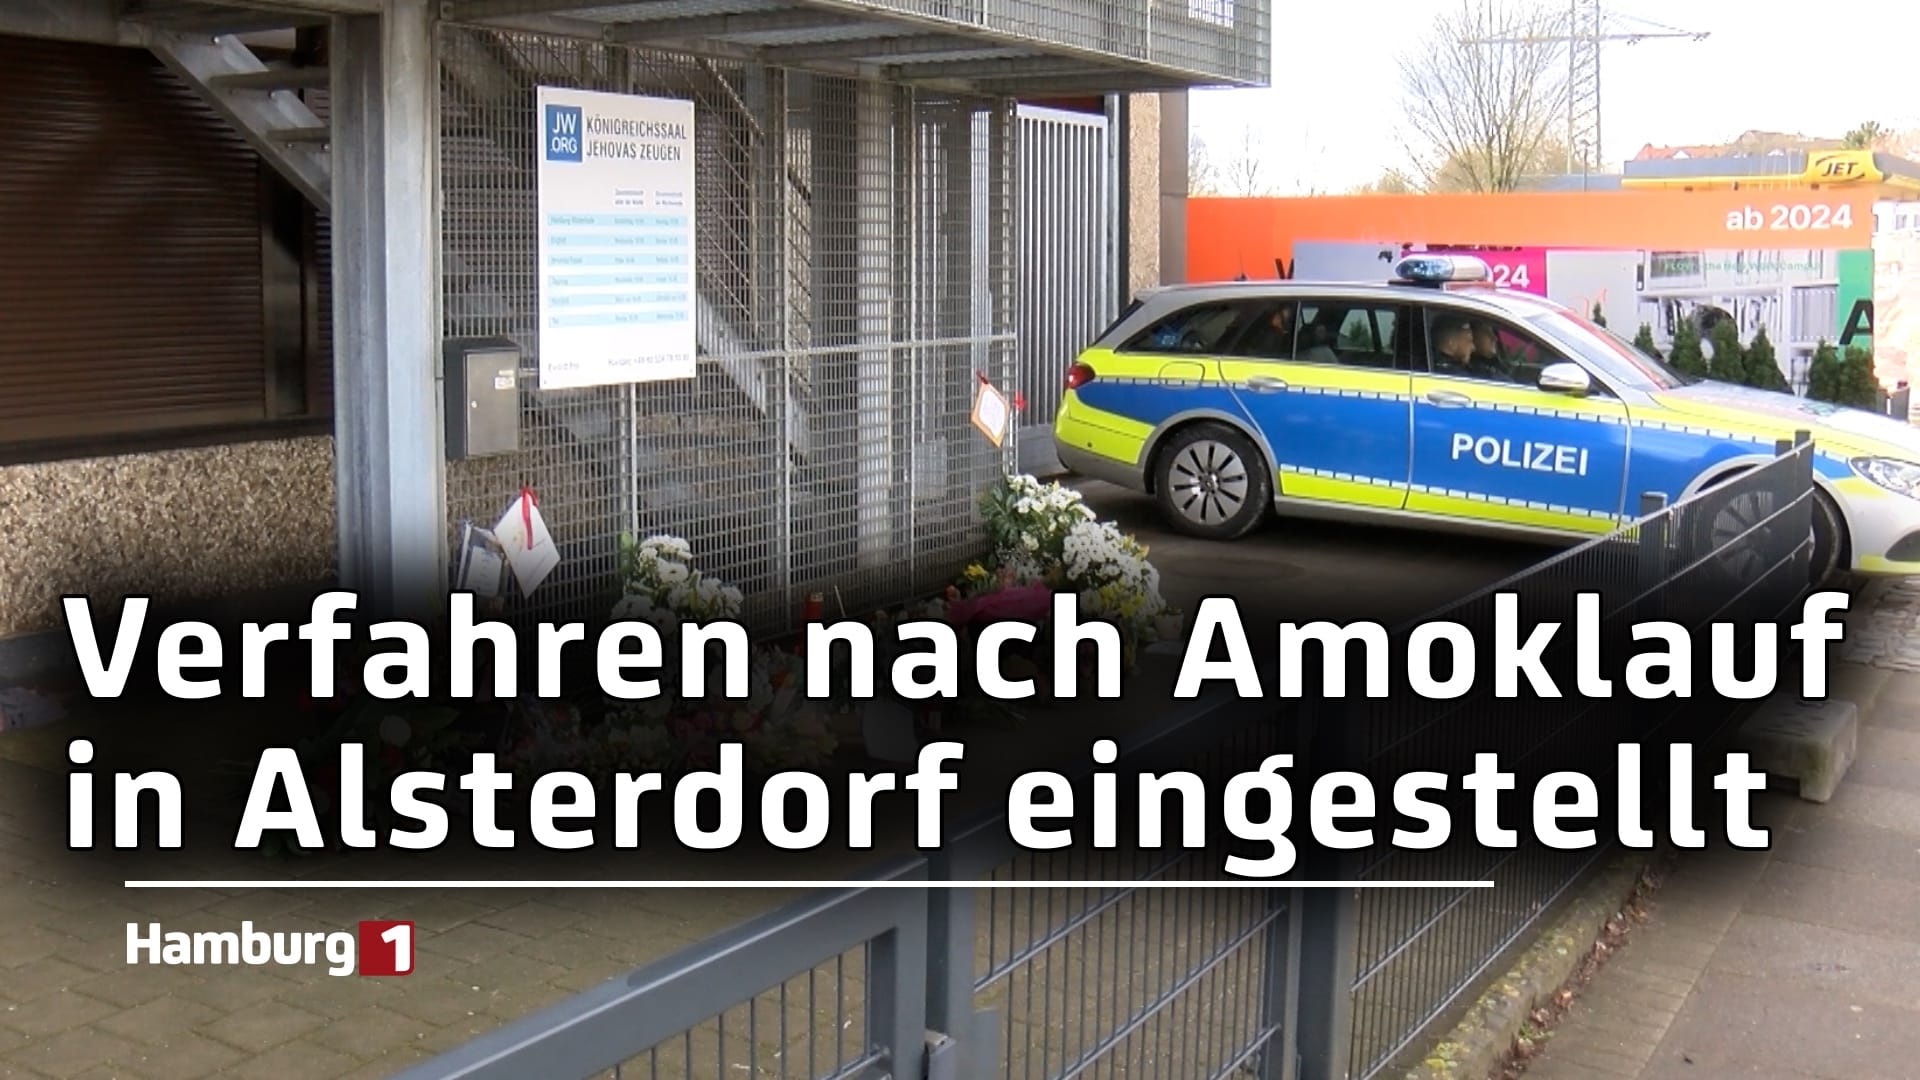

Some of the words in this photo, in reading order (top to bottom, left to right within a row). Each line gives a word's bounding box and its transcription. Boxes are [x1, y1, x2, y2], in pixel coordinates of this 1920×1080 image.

[552, 112, 577, 135] JW
[586, 114, 687, 140] KÖNIGREICHSSAAL
[586, 141, 636, 160] JEHOVAS
[640, 144, 681, 161] ZEUGEN
[1822, 162, 1858, 177] JET
[1726, 205, 1764, 230] ab
[1770, 204, 1853, 230] 2024
[1490, 263, 1530, 288] 24
[1452, 433, 1588, 476] POLIZEI
